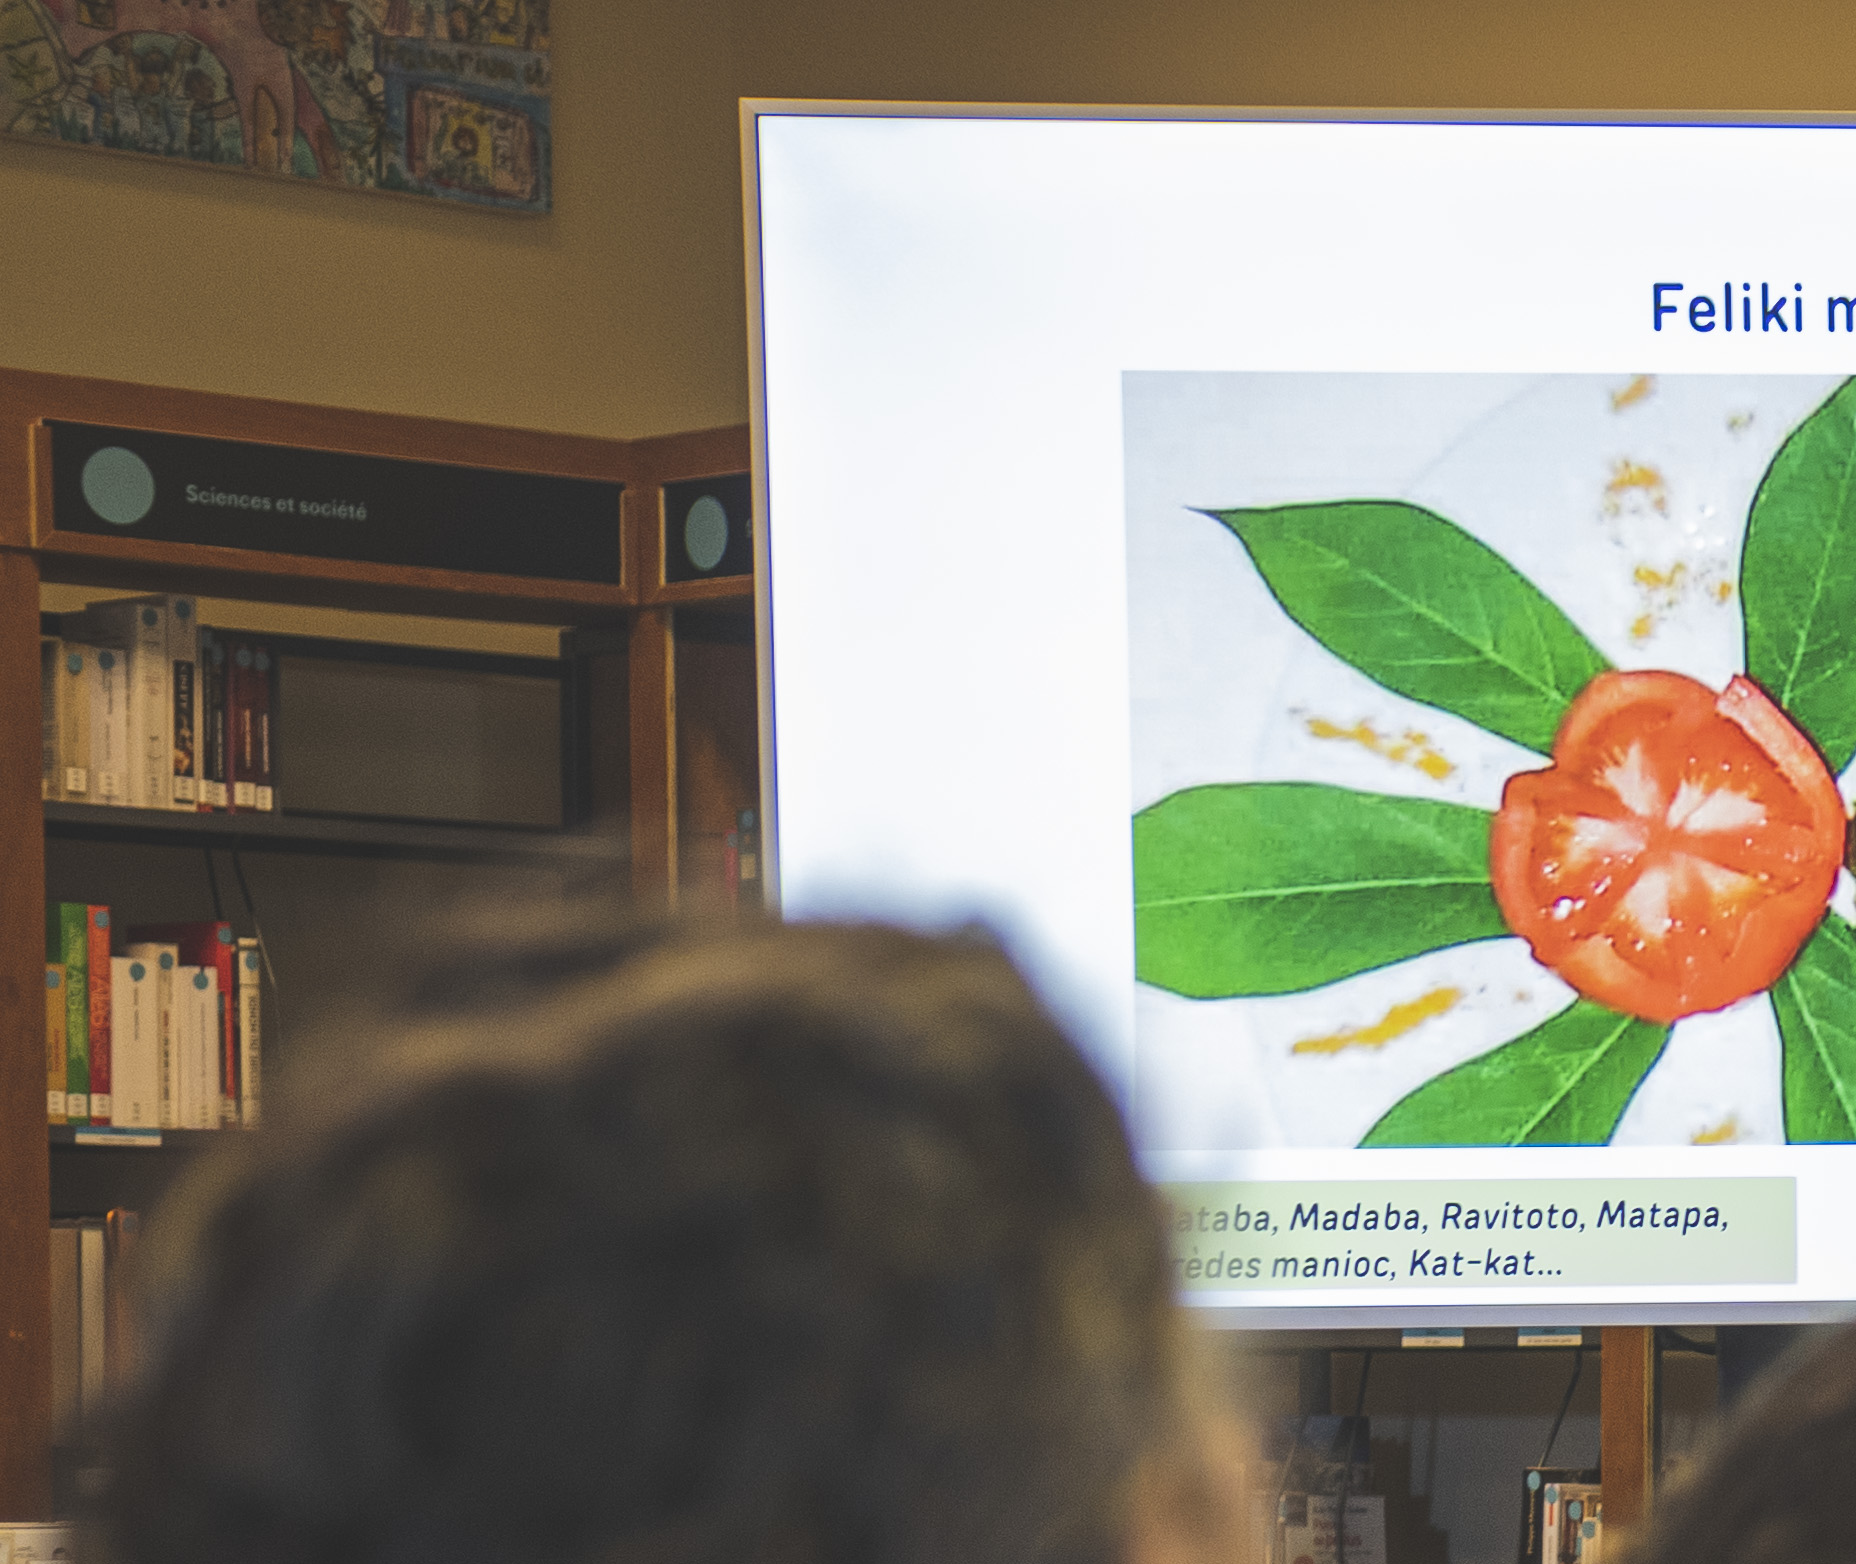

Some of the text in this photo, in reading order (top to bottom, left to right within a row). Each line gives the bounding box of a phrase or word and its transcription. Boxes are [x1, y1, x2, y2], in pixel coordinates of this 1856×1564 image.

[1652, 281, 1803, 333] Feliki
[186, 485, 367, 521] Sciences et société
[1178, 1200, 1728, 1236] ataba, Madaba, Ravitoto, Matapa,
[1272, 1249, 1396, 1281] manioc,
[1409, 1247, 1562, 1277] Kat-kat...
